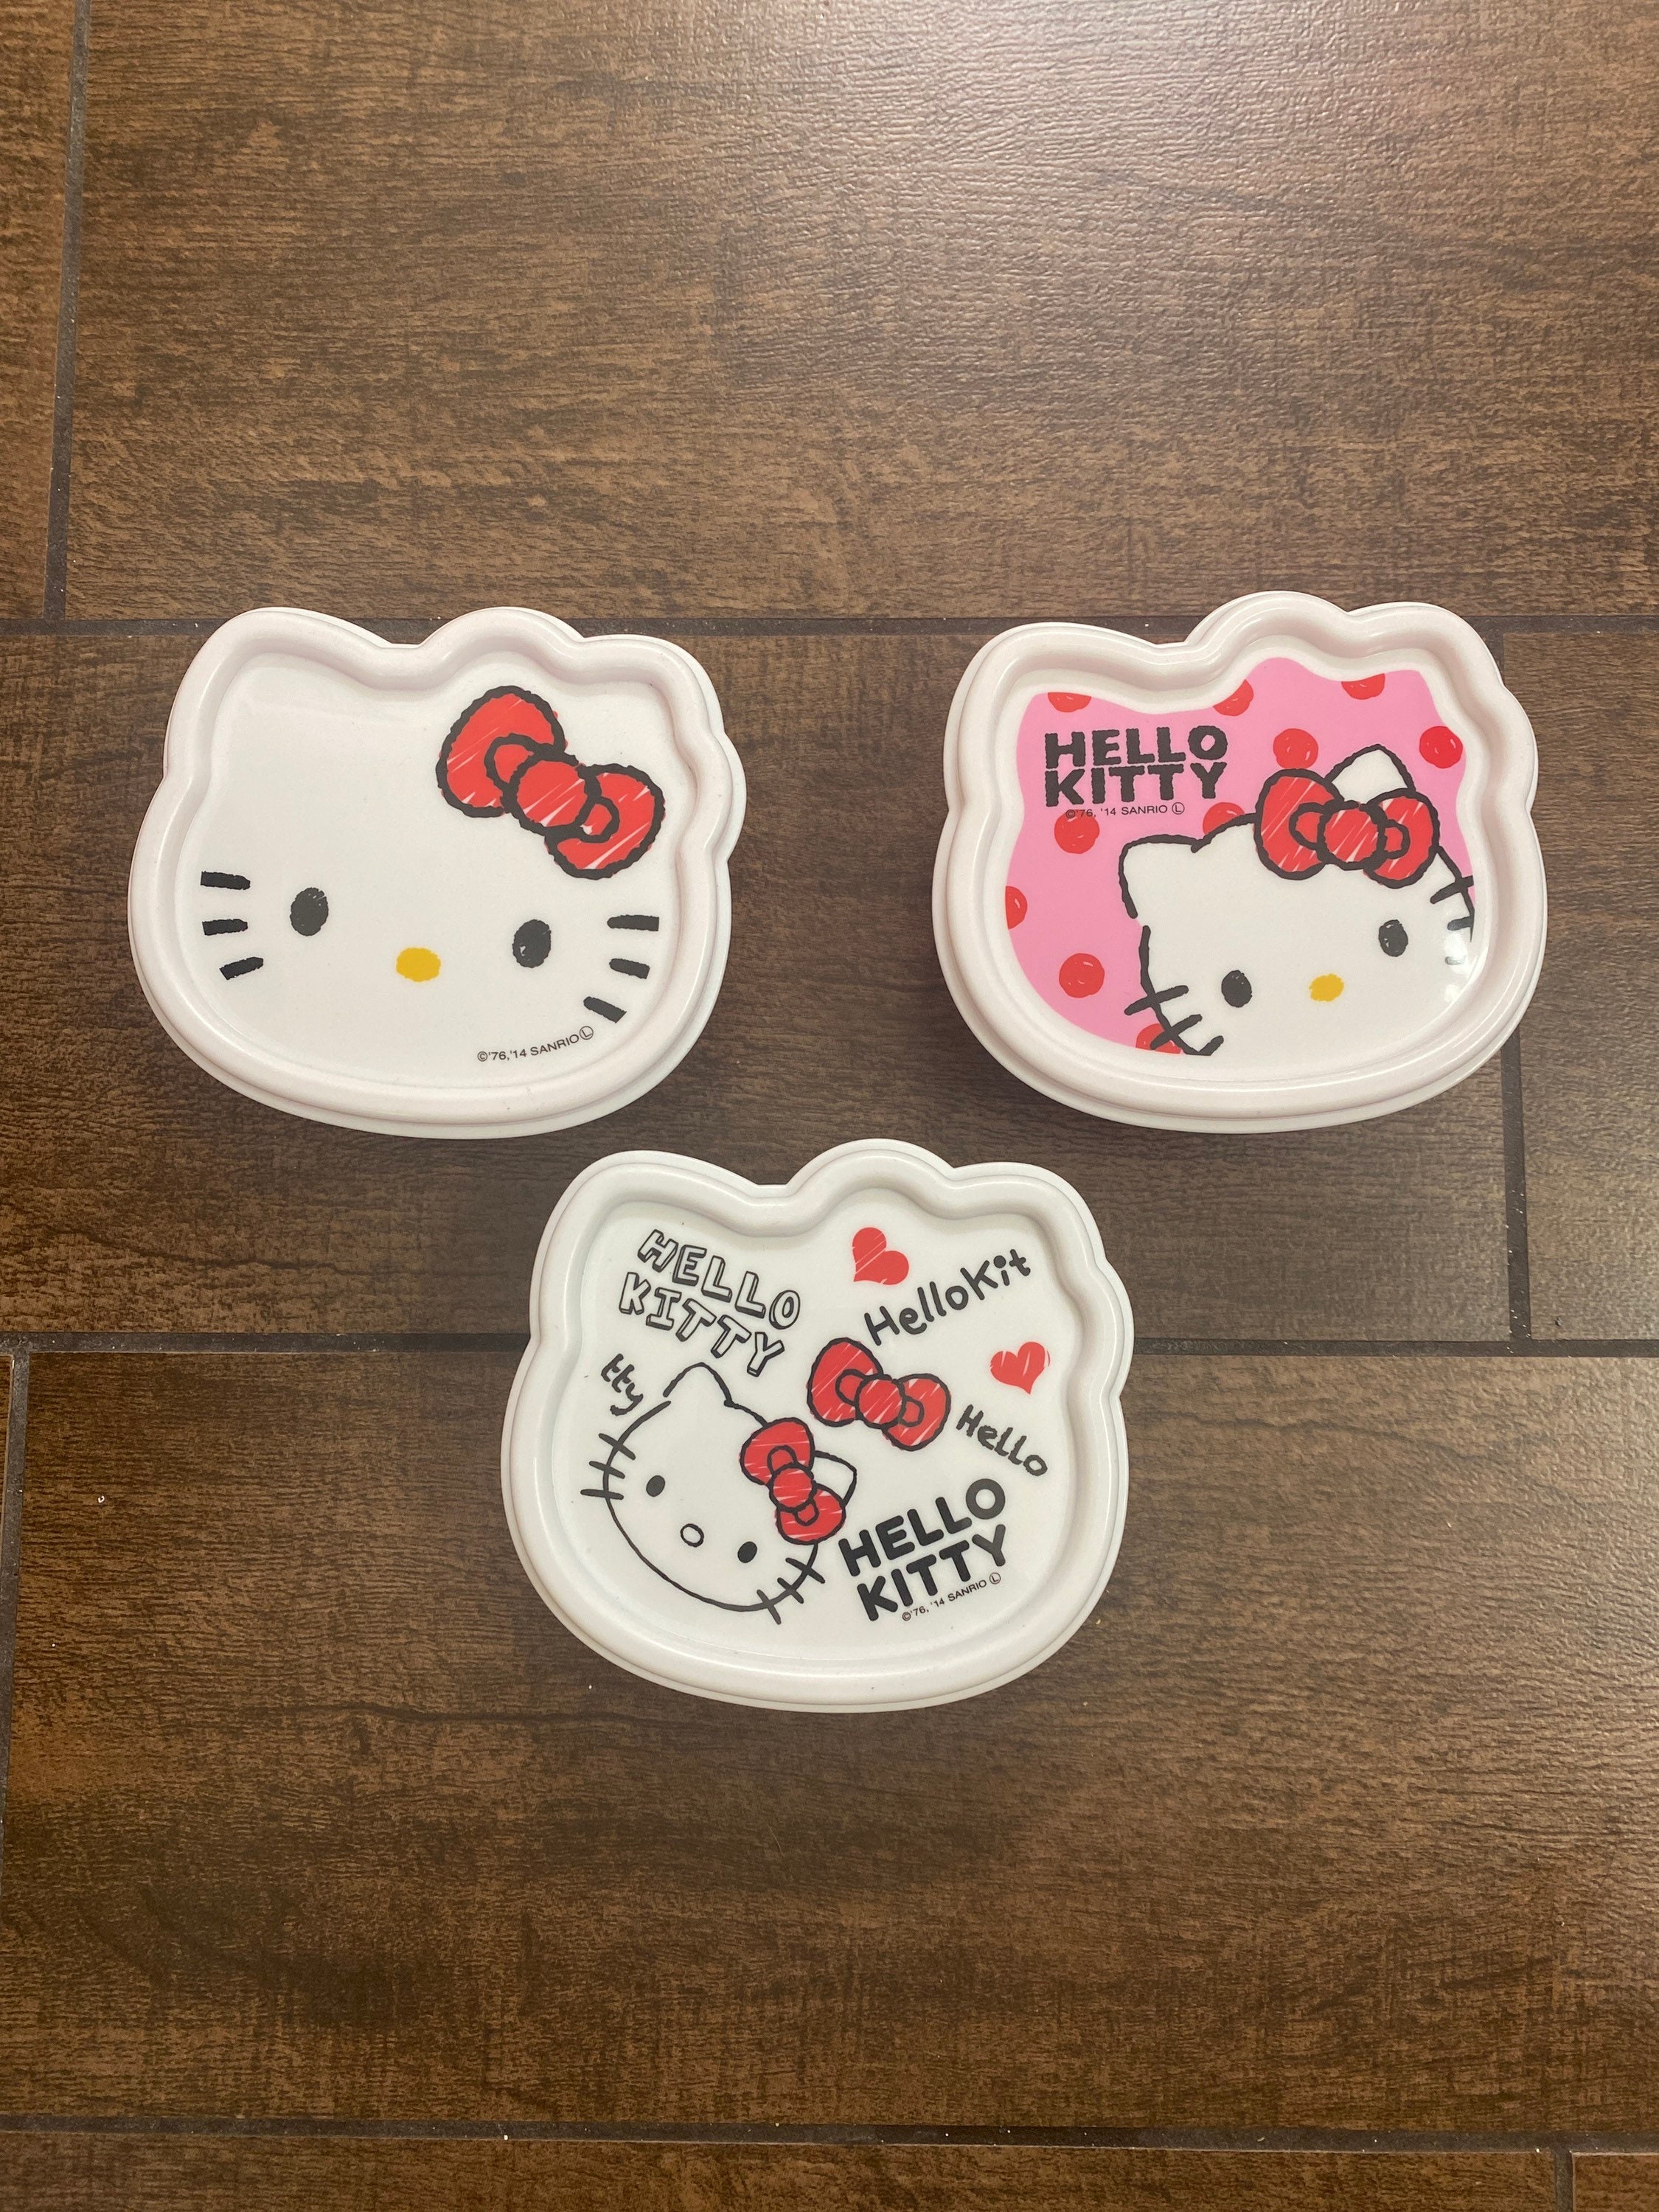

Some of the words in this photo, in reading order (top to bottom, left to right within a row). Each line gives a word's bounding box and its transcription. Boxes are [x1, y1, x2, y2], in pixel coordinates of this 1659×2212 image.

[1045, 726, 1228, 769] HELLO
[1045, 762, 1227, 807] KITTY
[1121, 804, 1168, 815] SANRIO
[530, 1034, 579, 1056] SANRIO
[637, 1228, 801, 1330] HELLO
[619, 1272, 785, 1377] KITTY
[601, 1353, 644, 1416] tty
[838, 1478, 1006, 1576] HELLO
[857, 1524, 1006, 1621] KITTY
[948, 1579, 987, 1601] SANRIO
